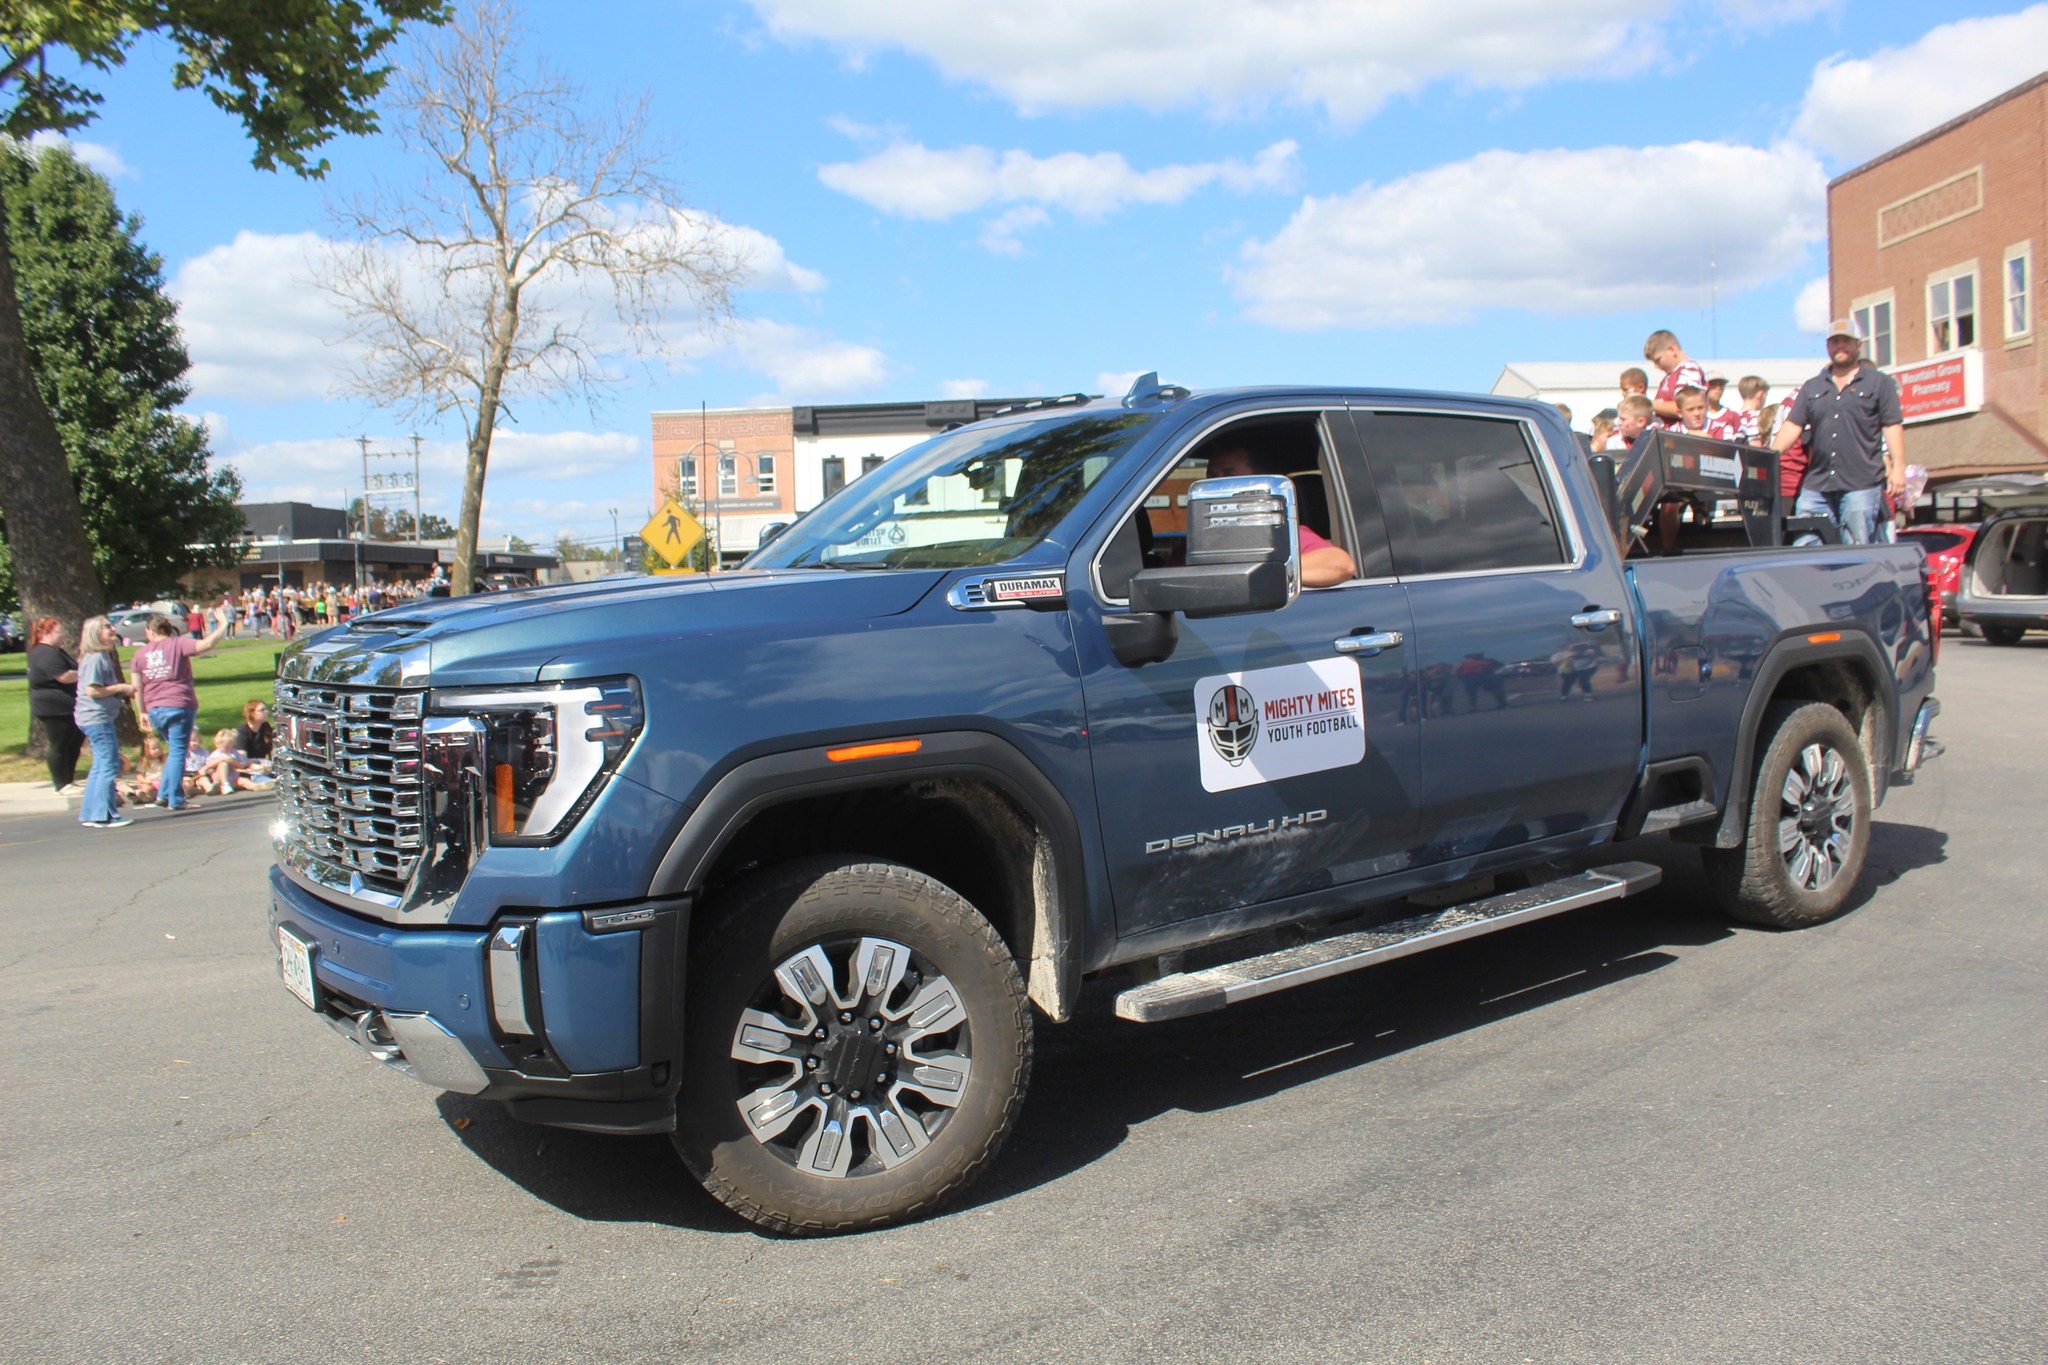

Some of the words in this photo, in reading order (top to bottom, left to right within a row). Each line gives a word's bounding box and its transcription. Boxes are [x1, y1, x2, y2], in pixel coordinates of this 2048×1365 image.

[1902, 368, 1936, 385] Mountain
[1937, 363, 1962, 377] Grove
[1912, 380, 1951, 397] Pharmacy
[999, 579, 1057, 592] DURAMAX
[1214, 702, 1225, 719] M
[1239, 697, 1249, 715] M
[1264, 693, 1313, 721] MIGHTY
[1317, 687, 1355, 712] MITES
[1267, 723, 1303, 744] YOUTH
[1307, 714, 1358, 737] FOOTBALL
[1145, 818, 1275, 854] DENALI
[1281, 809, 1327, 828] HD
